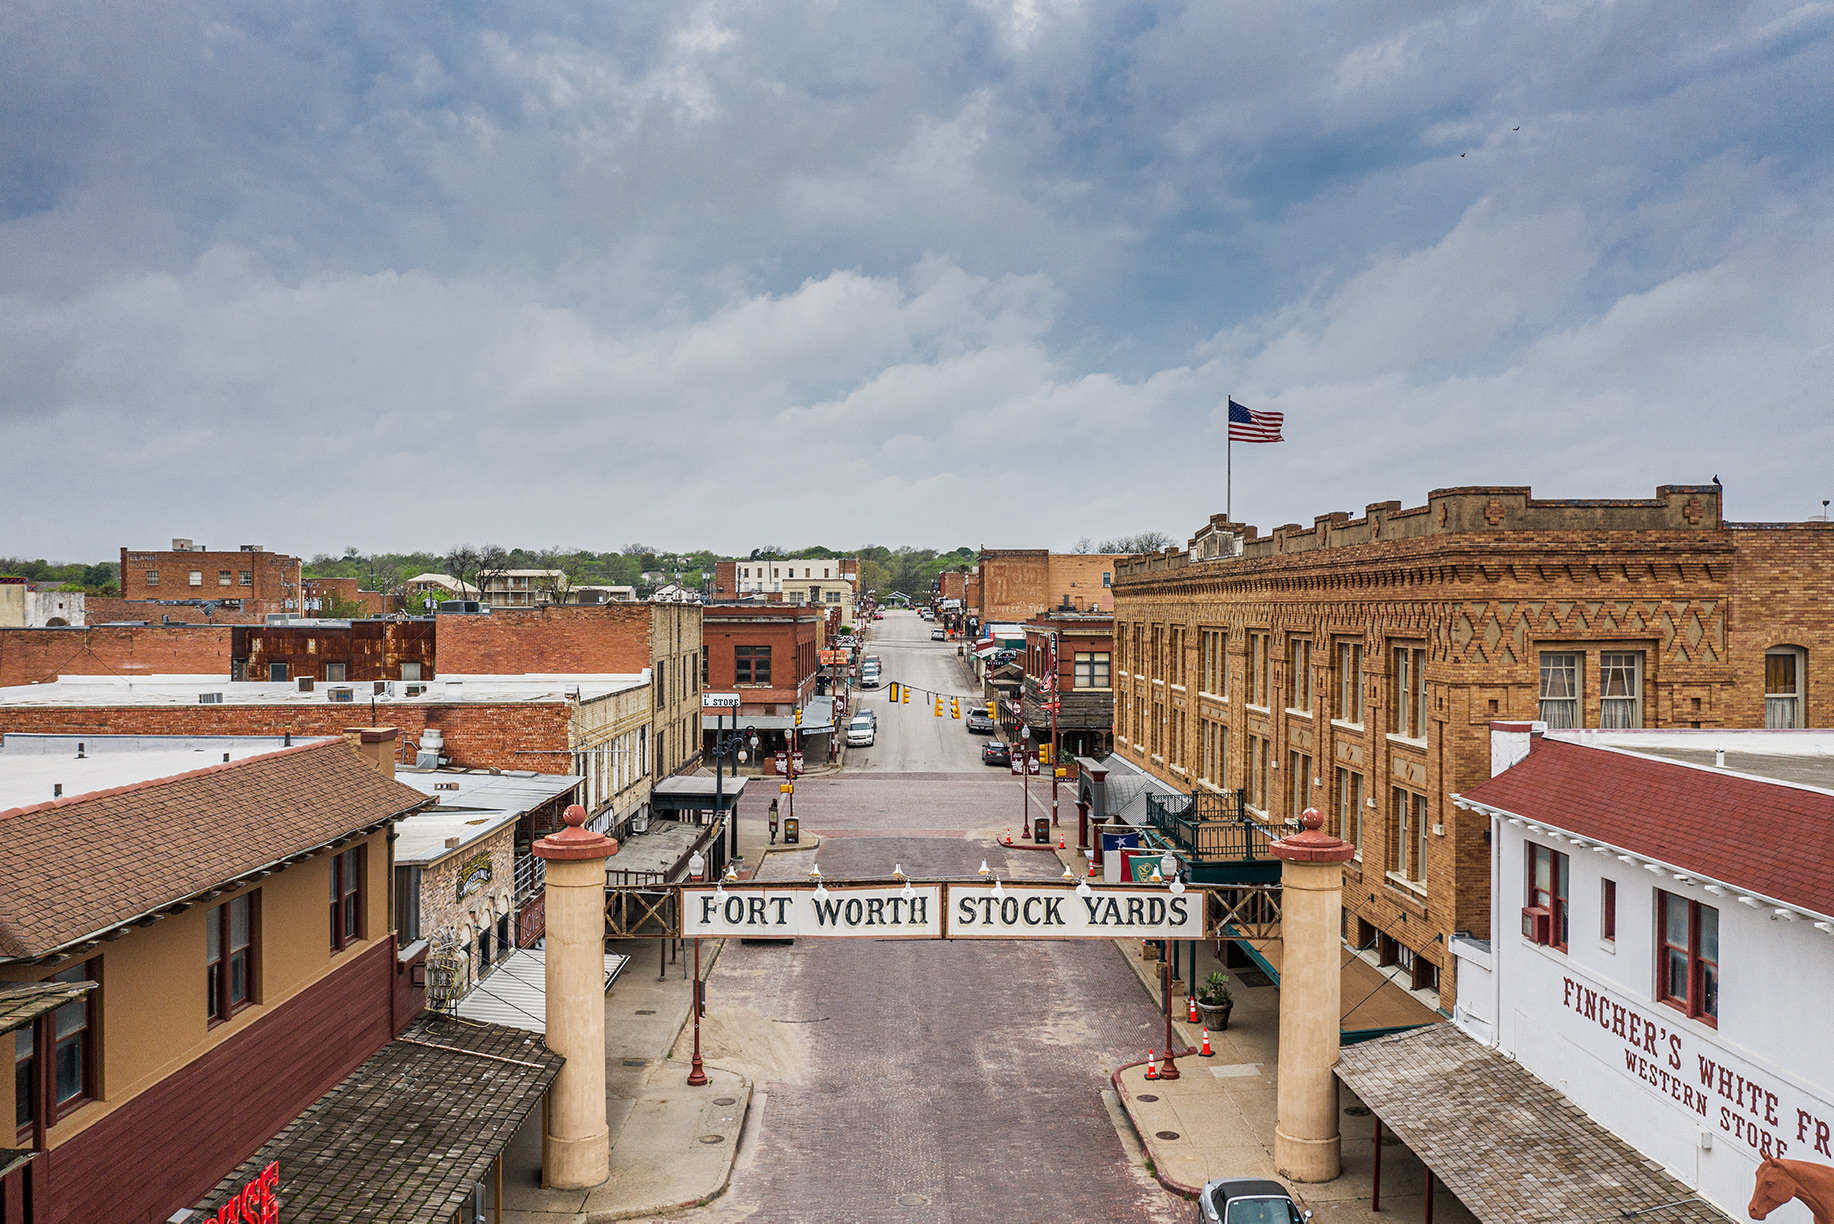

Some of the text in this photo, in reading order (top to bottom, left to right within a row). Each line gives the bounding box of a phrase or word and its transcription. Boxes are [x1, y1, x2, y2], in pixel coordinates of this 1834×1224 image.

[712, 698, 739, 706] STORE
[699, 895, 1188, 926] FORT WORTH STOCK YARDS
[1563, 976, 1832, 1159] FINCHER'S WHITE FR
[1624, 1048, 1788, 1159] WESTERN STORE
